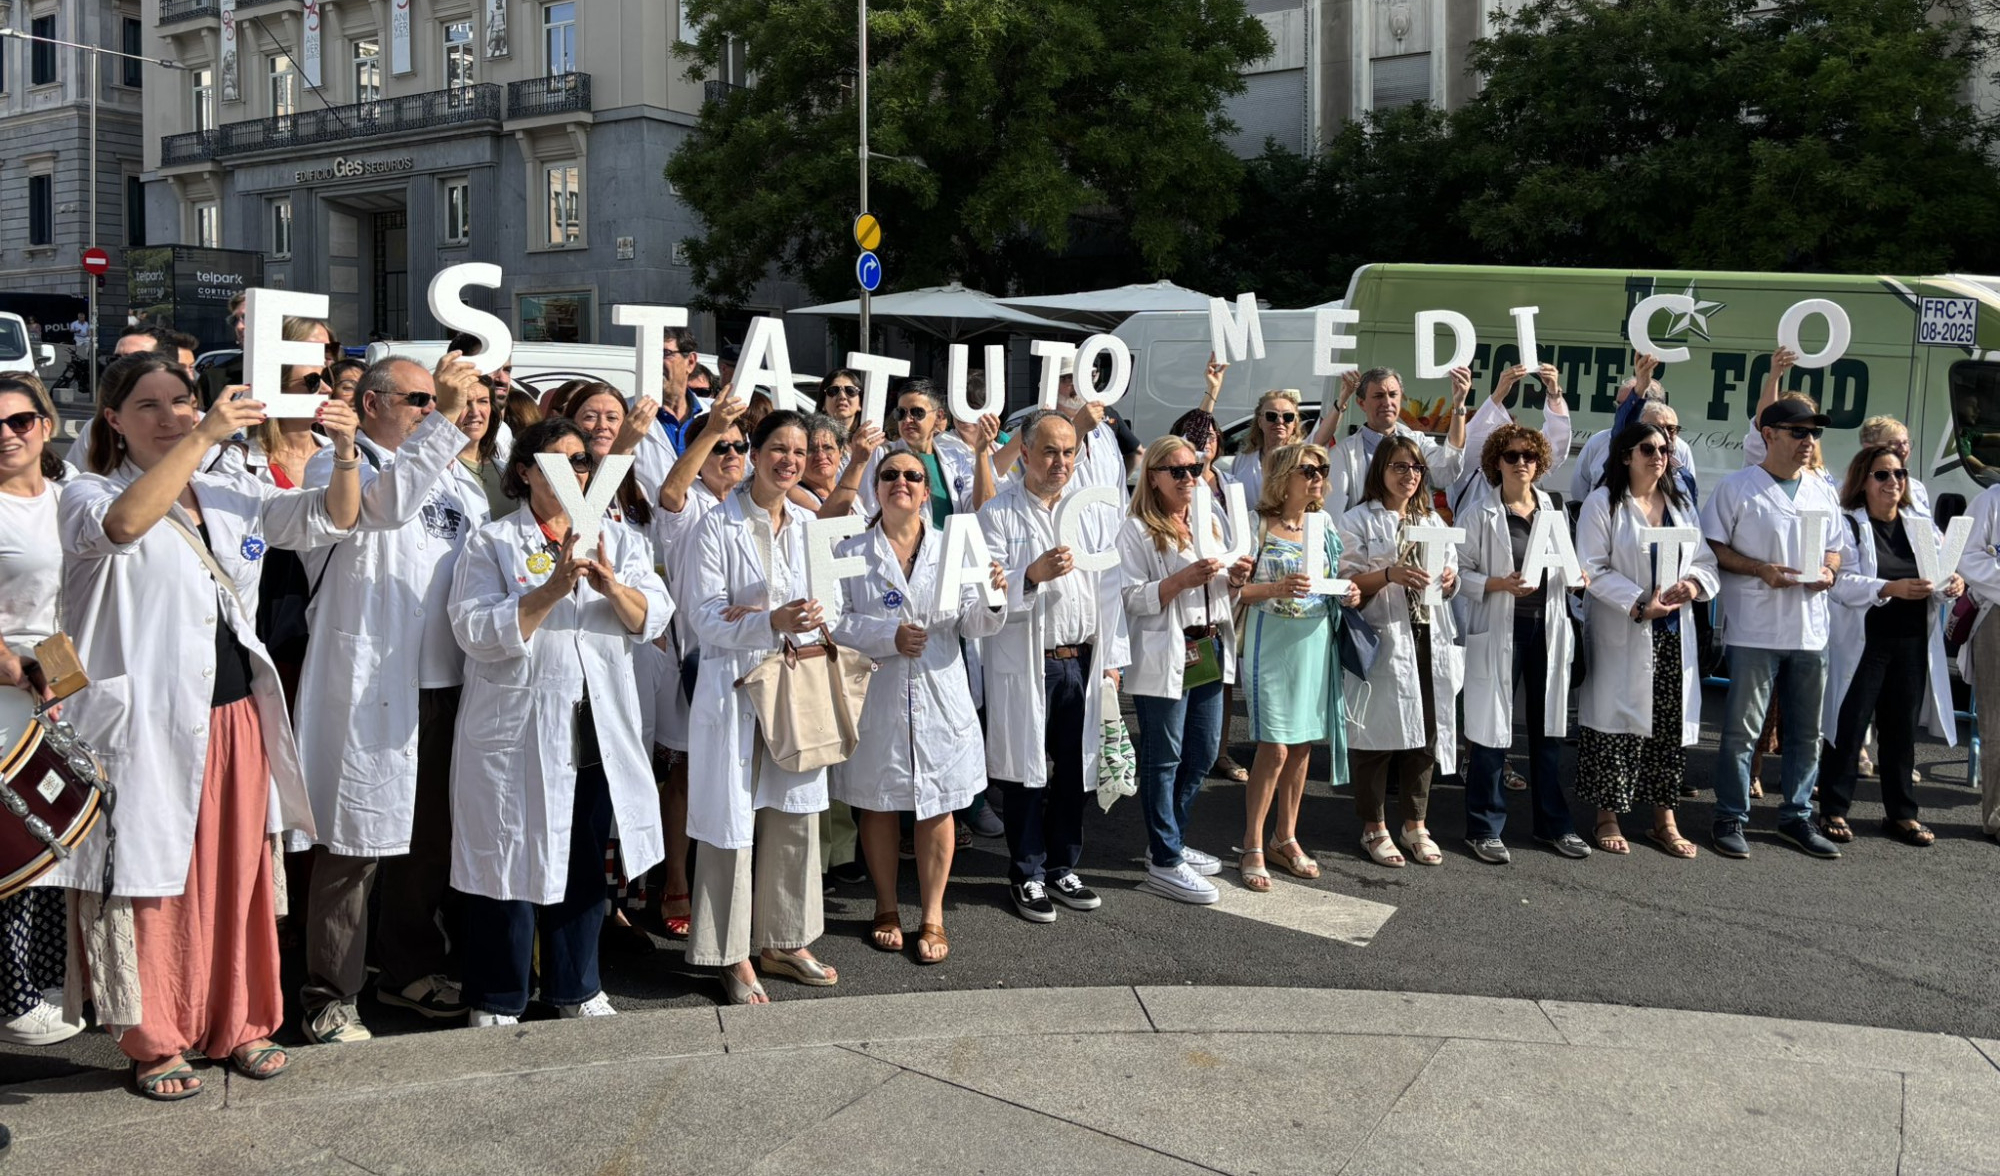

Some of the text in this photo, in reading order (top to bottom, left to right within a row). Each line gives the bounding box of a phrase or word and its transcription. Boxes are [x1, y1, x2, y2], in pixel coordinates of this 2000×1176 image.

[295, 156, 412, 183] EDIFICIO Ges SEGUROS
[136, 270, 164, 282] telpark
[195, 270, 243, 285] telpark
[197, 287, 232, 296] CORTES
[1923, 300, 1973, 320] FRC-X
[44, 322, 71, 333] POLI
[1920, 321, 1974, 343] 08-2025
